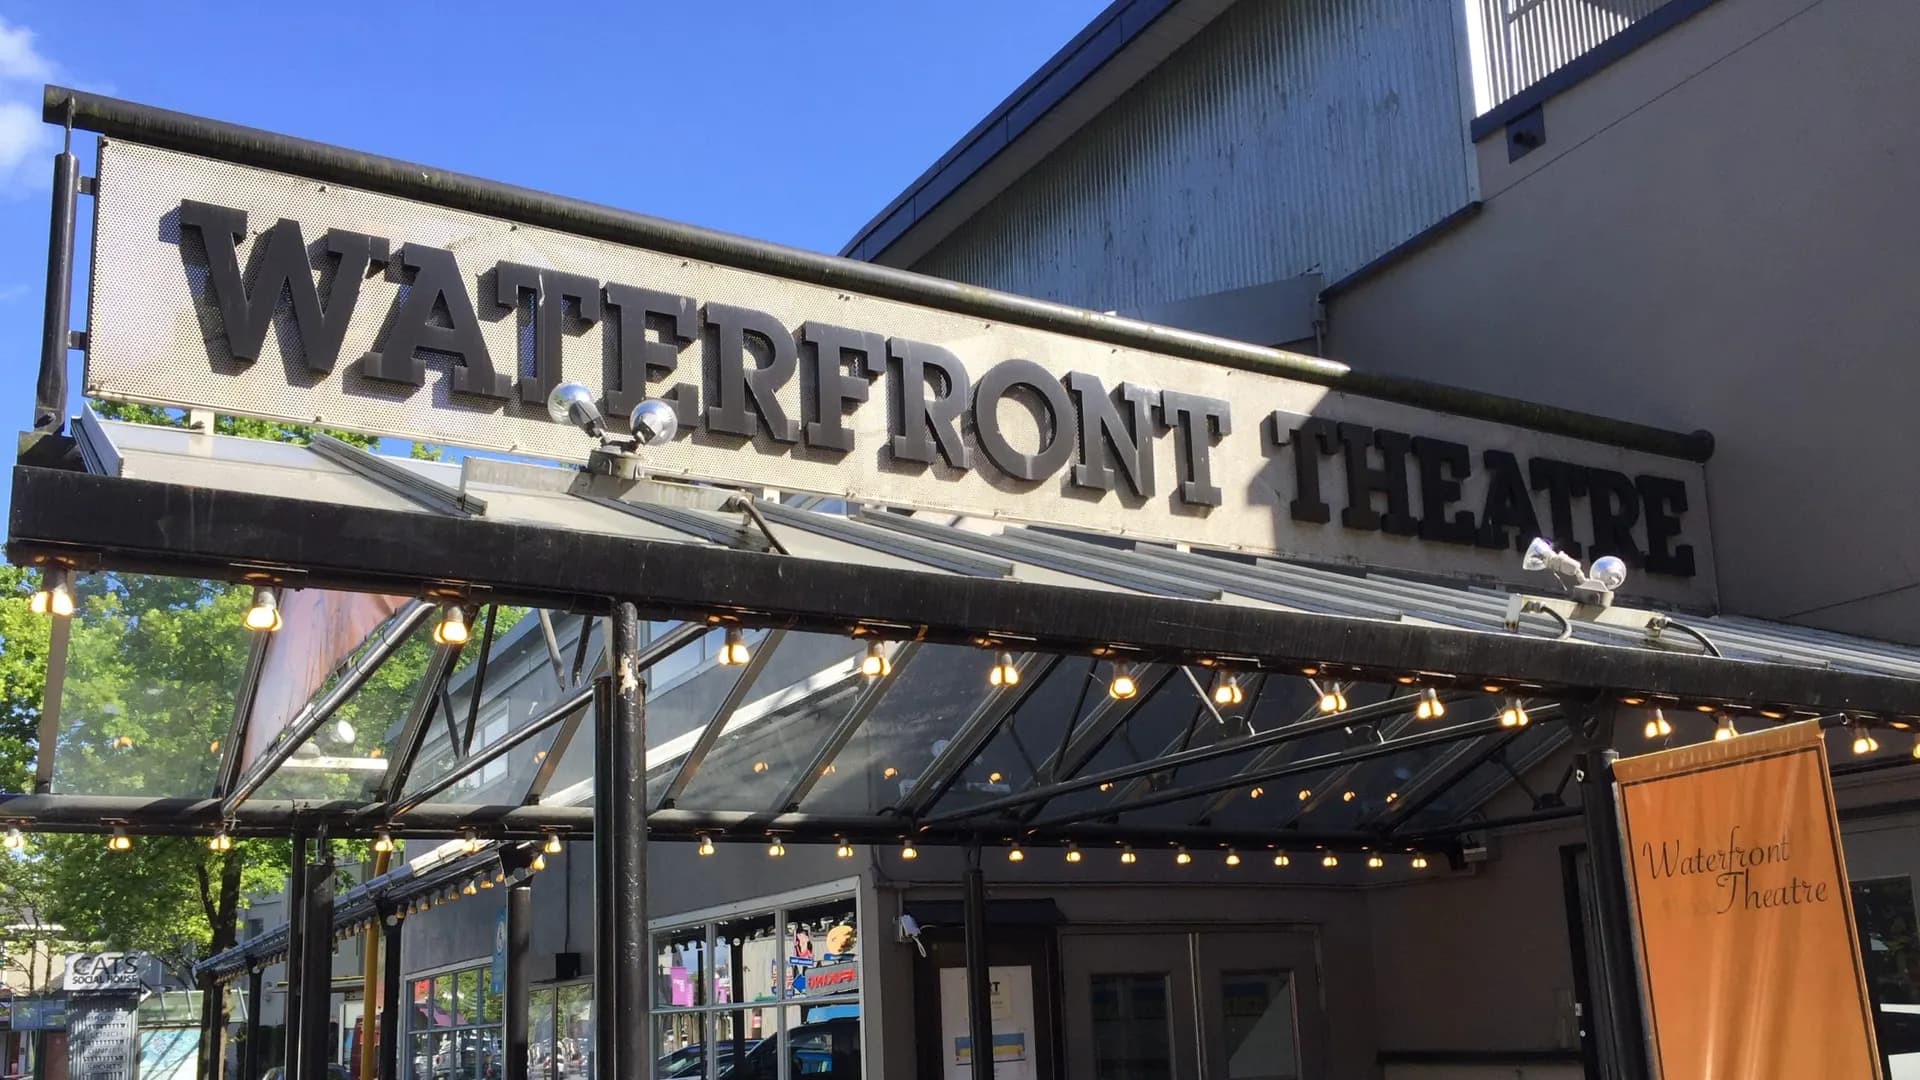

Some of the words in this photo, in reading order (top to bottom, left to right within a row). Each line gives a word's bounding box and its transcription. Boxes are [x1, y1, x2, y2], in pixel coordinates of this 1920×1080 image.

[180, 198, 1231, 507] WATERFRONT
[1271, 409, 1695, 577] THEATRE
[1643, 825, 1790, 879] Waterfront
[1716, 868, 1828, 914] Theatre
[72, 975, 105, 984] SOCIAL
[73, 956, 138, 975] CATS
